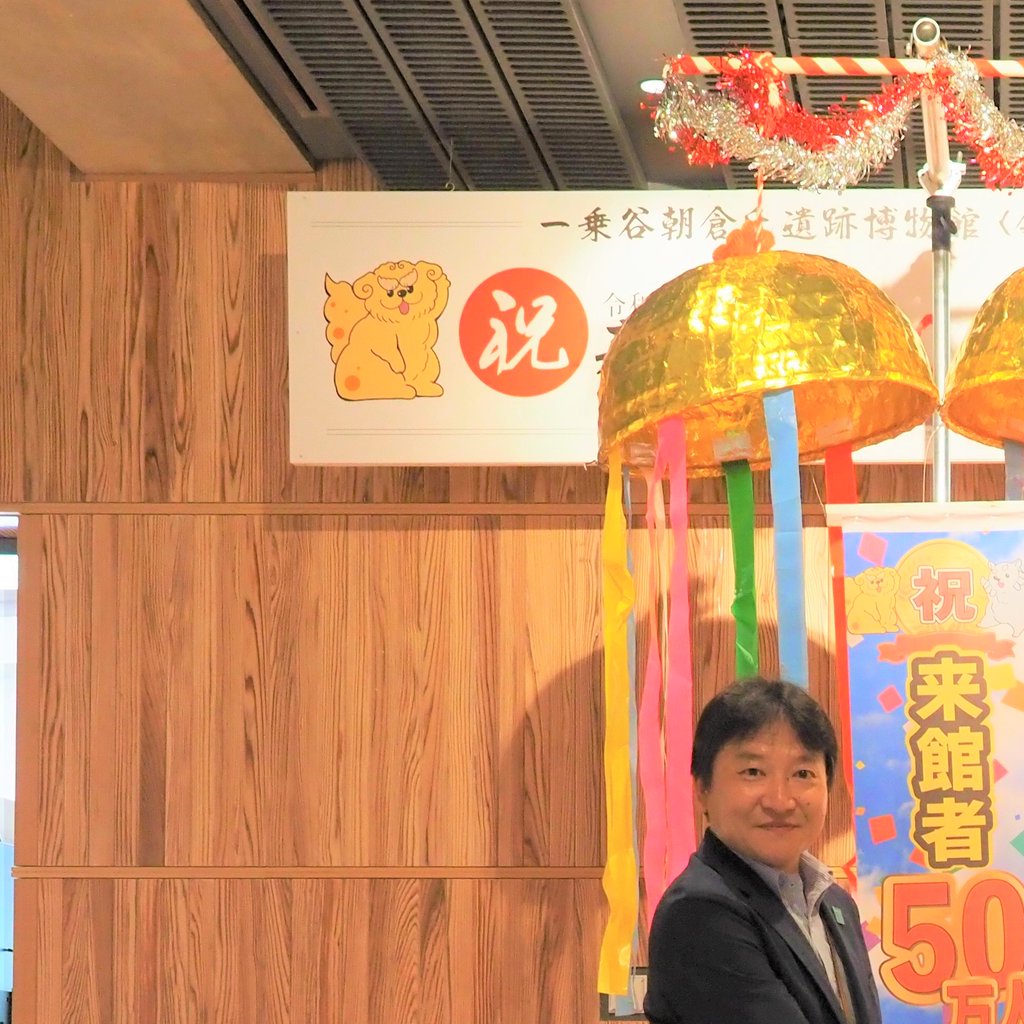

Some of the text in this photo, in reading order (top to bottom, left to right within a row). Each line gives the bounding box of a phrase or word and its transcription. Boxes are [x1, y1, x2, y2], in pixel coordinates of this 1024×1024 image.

[478, 289, 571, 372] 祝
[912, 566, 979, 625] 祝
[910, 652, 992, 867] 来館者
